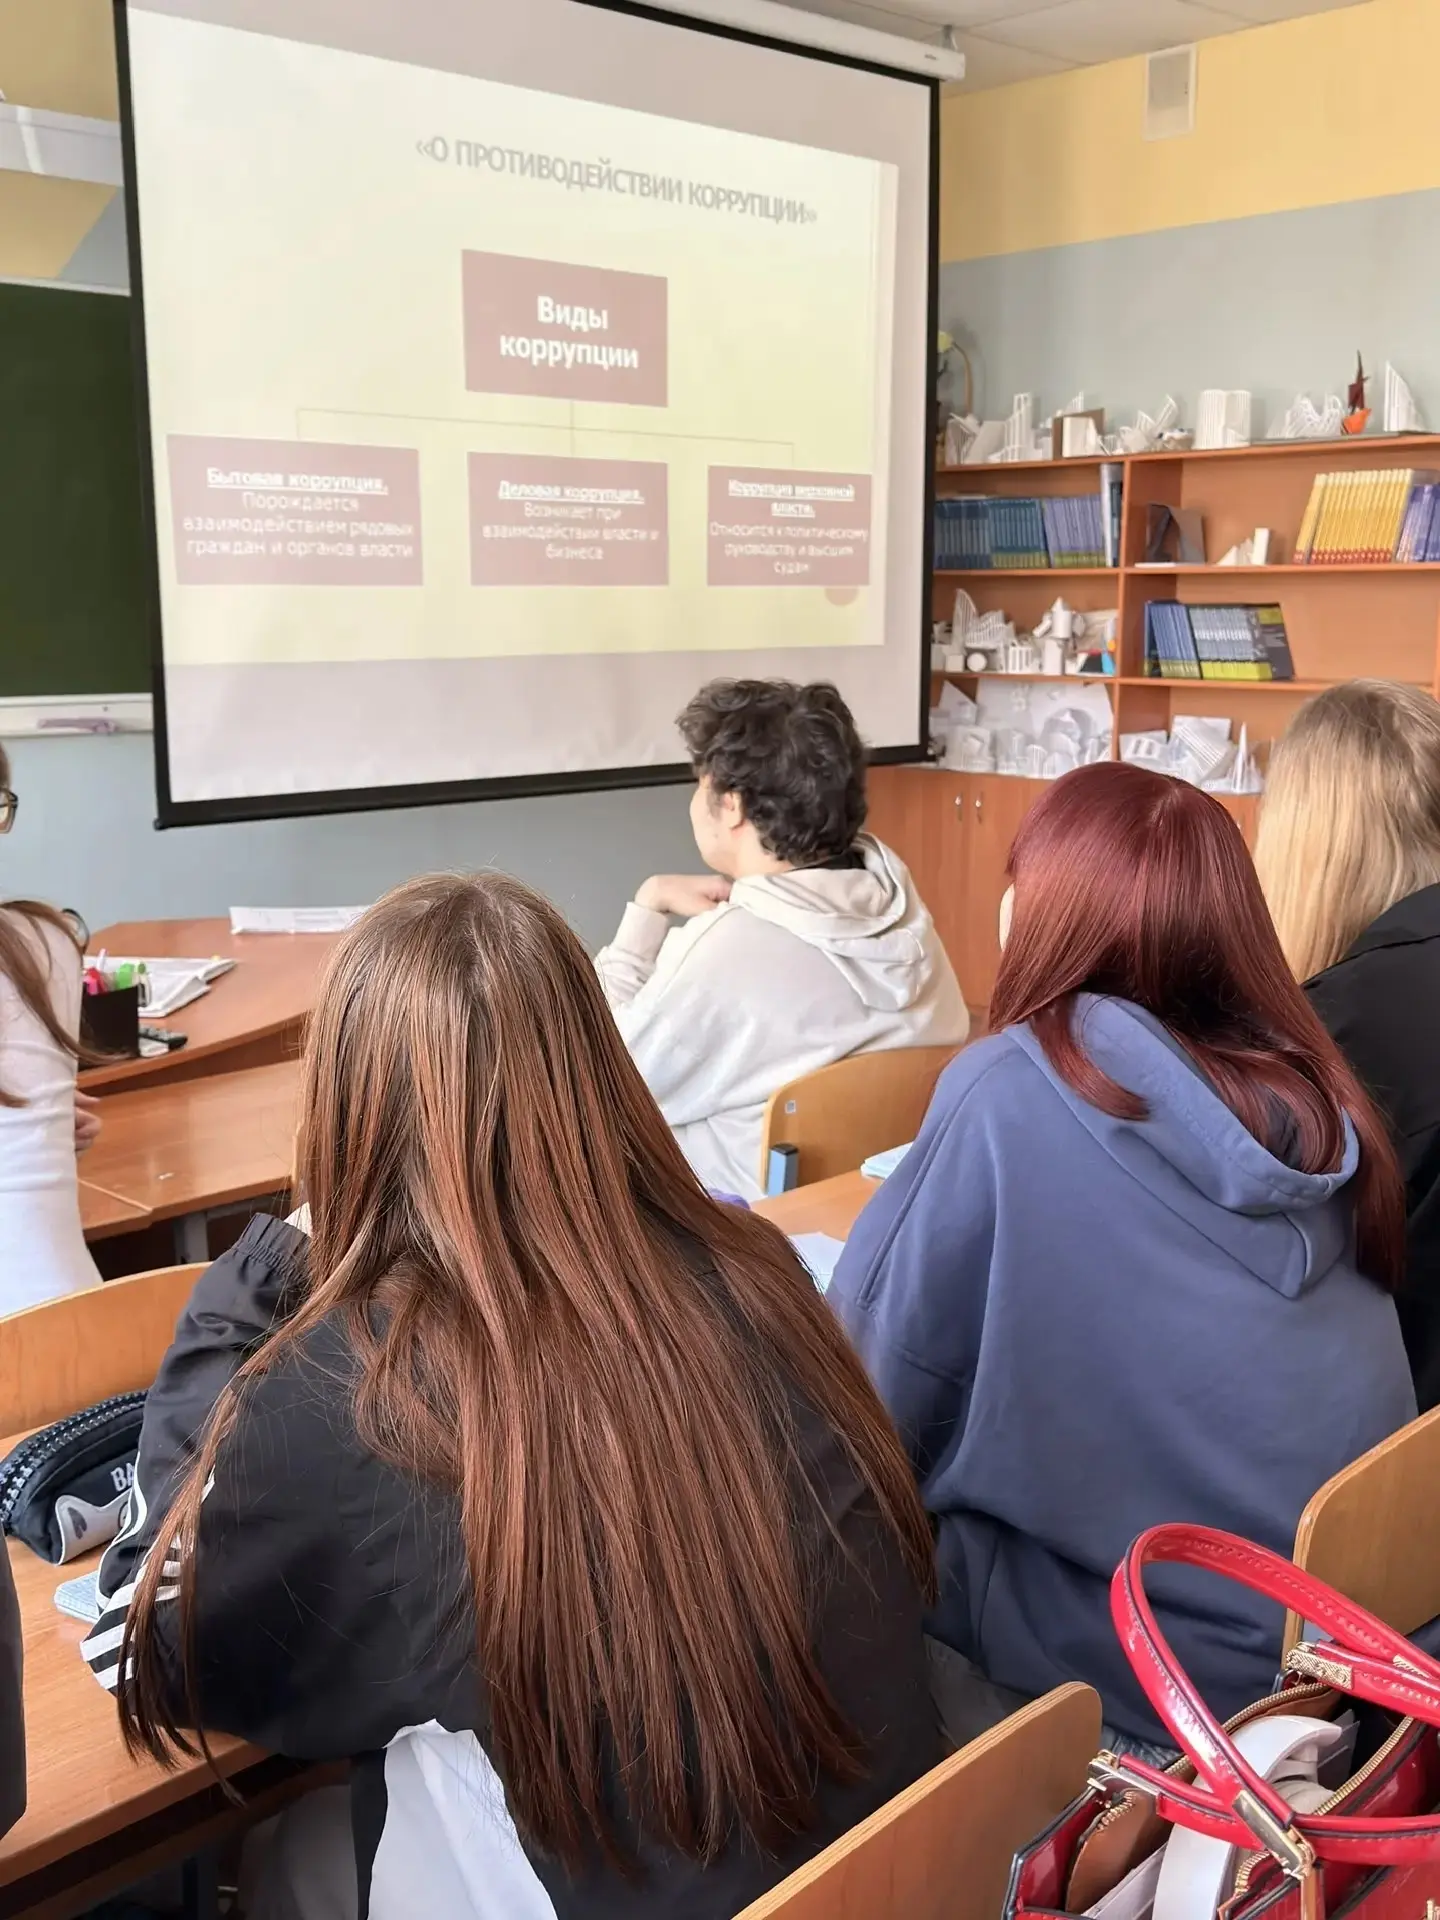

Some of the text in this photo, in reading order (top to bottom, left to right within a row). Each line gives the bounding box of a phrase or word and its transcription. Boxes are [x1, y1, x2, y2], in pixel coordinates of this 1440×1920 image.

[455, 139, 683, 204] ПРОТИВОДЕЙСТВИИ
[687, 181, 818, 224] КОРРУПЦИИ»
[536, 295, 609, 331] Виды
[500, 335, 640, 370] коррупции
[206, 467, 284, 487] Бытовая
[242, 491, 360, 513] Порождается
[183, 515, 415, 538] взаимодействием рядовых
[186, 540, 414, 559] граждан и органов власти
